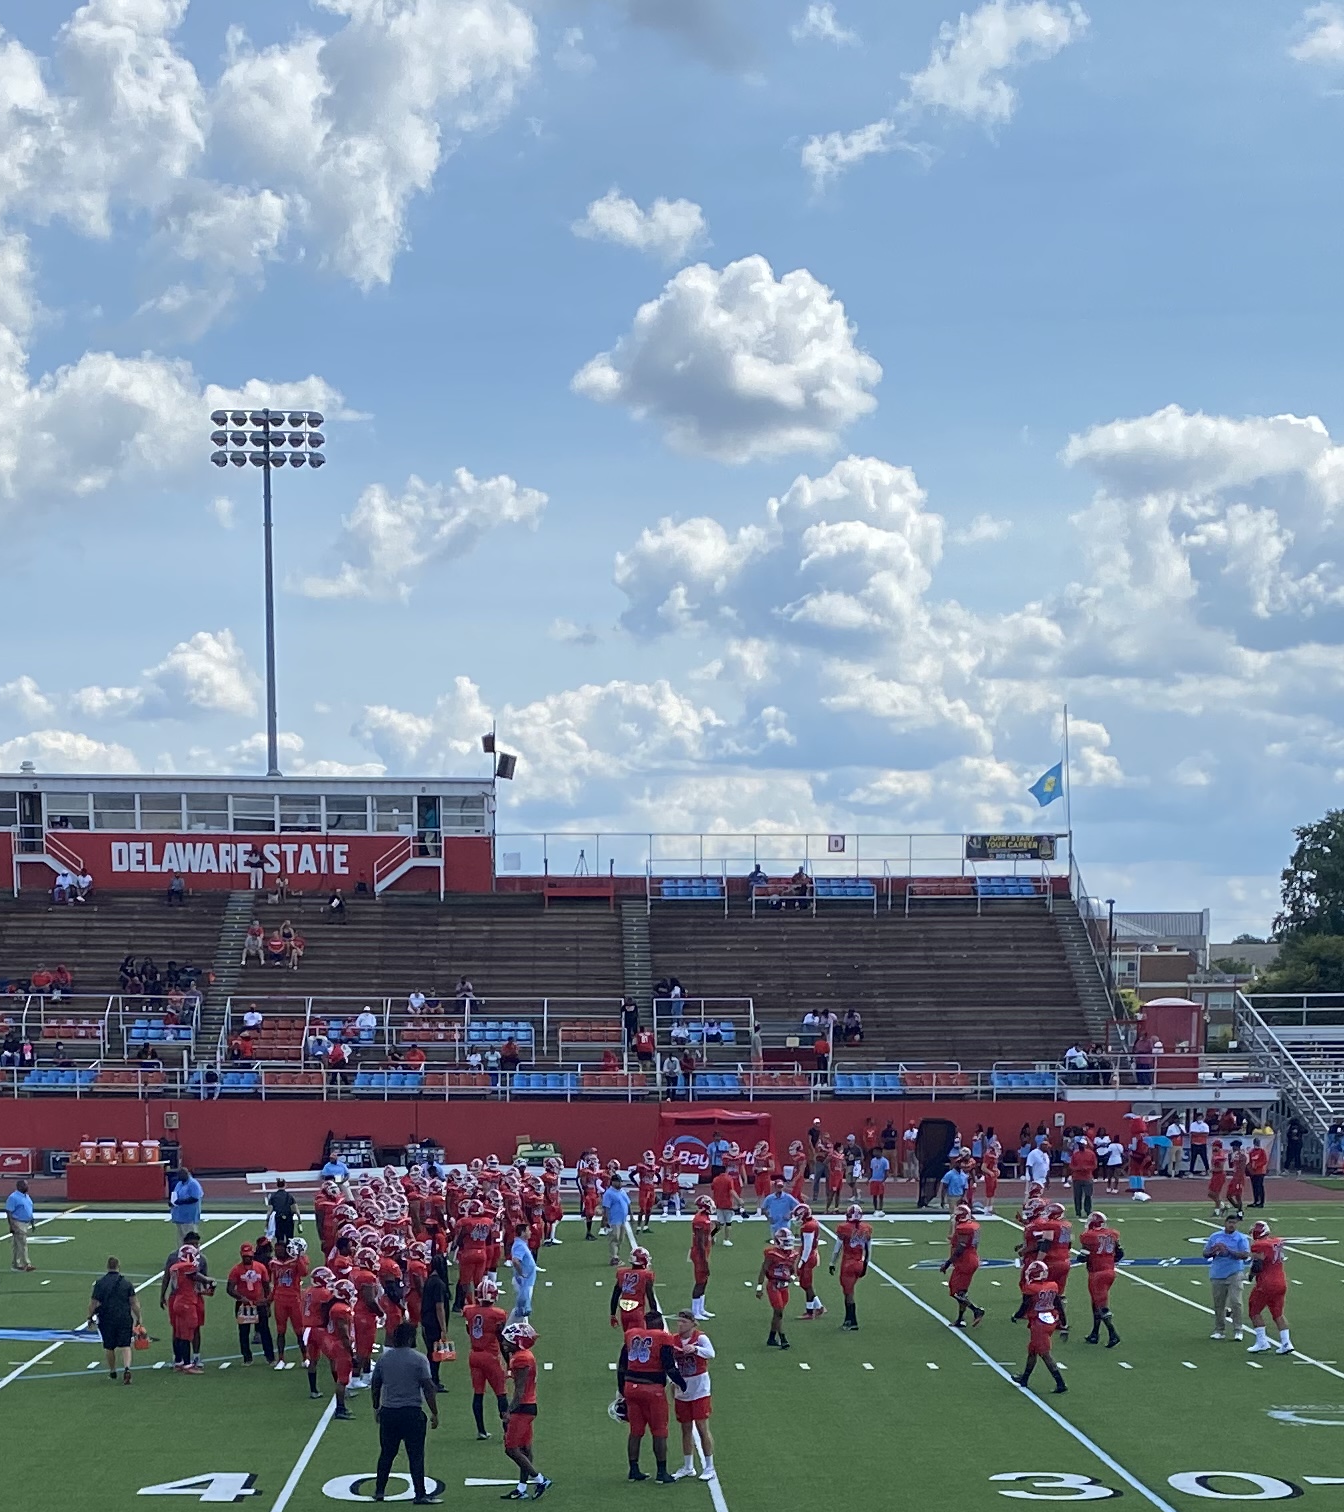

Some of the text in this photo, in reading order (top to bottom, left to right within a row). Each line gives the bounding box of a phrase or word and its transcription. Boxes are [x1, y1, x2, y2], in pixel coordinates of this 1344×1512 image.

[110, 841, 349, 875] DELAWARE STATE
[830, 836, 843, 851] D
[136, 1471, 447, 1504] 40
[988, 1470, 1305, 1502] 30
